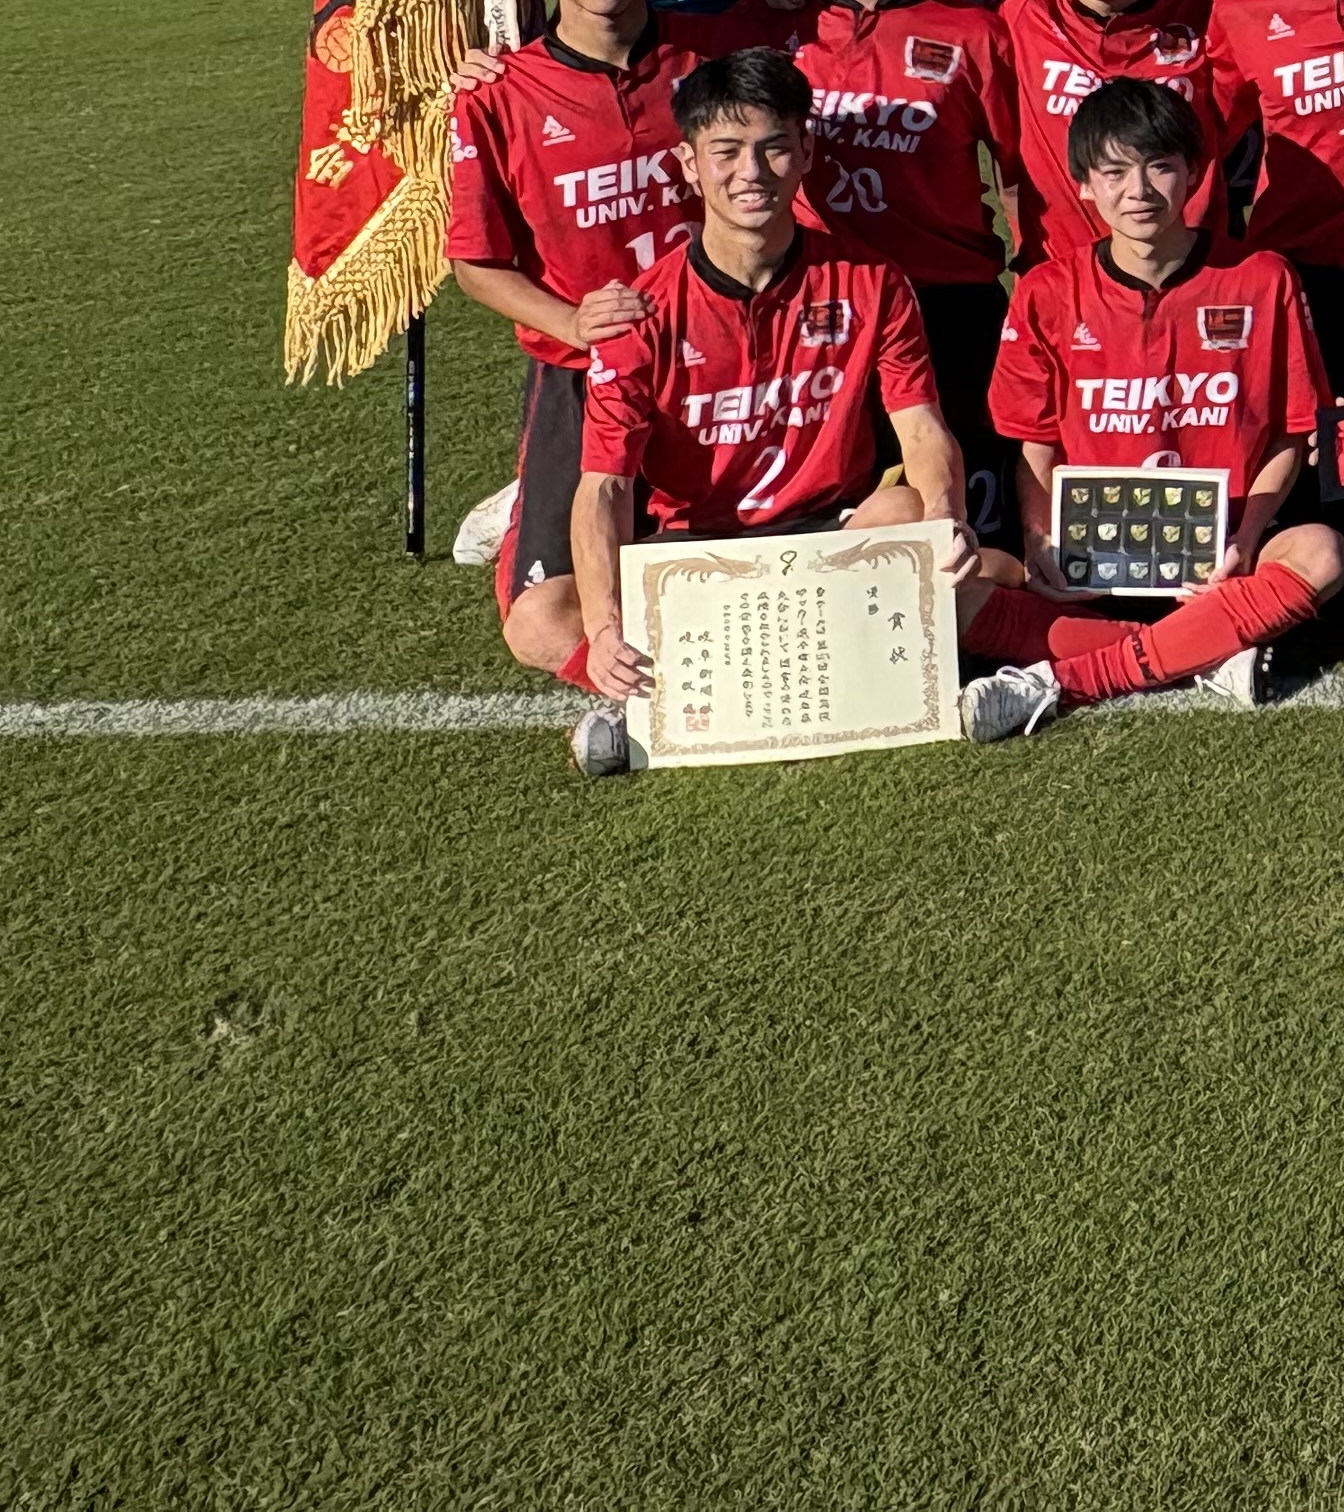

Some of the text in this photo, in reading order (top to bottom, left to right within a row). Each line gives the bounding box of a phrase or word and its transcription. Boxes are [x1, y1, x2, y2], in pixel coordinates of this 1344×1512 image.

[808, 88, 938, 132] EIKYO
[853, 131, 921, 153] KANI
[554, 148, 684, 206] TEIK
[826, 157, 888, 213] 20
[576, 201, 655, 228] UNIV.
[681, 366, 844, 428] TEIKYO
[1076, 372, 1239, 410] TEIKYO
[770, 403, 830, 428] KANI
[1090, 407, 1229, 434] UNIV. KANI
[738, 446, 785, 510] 2
